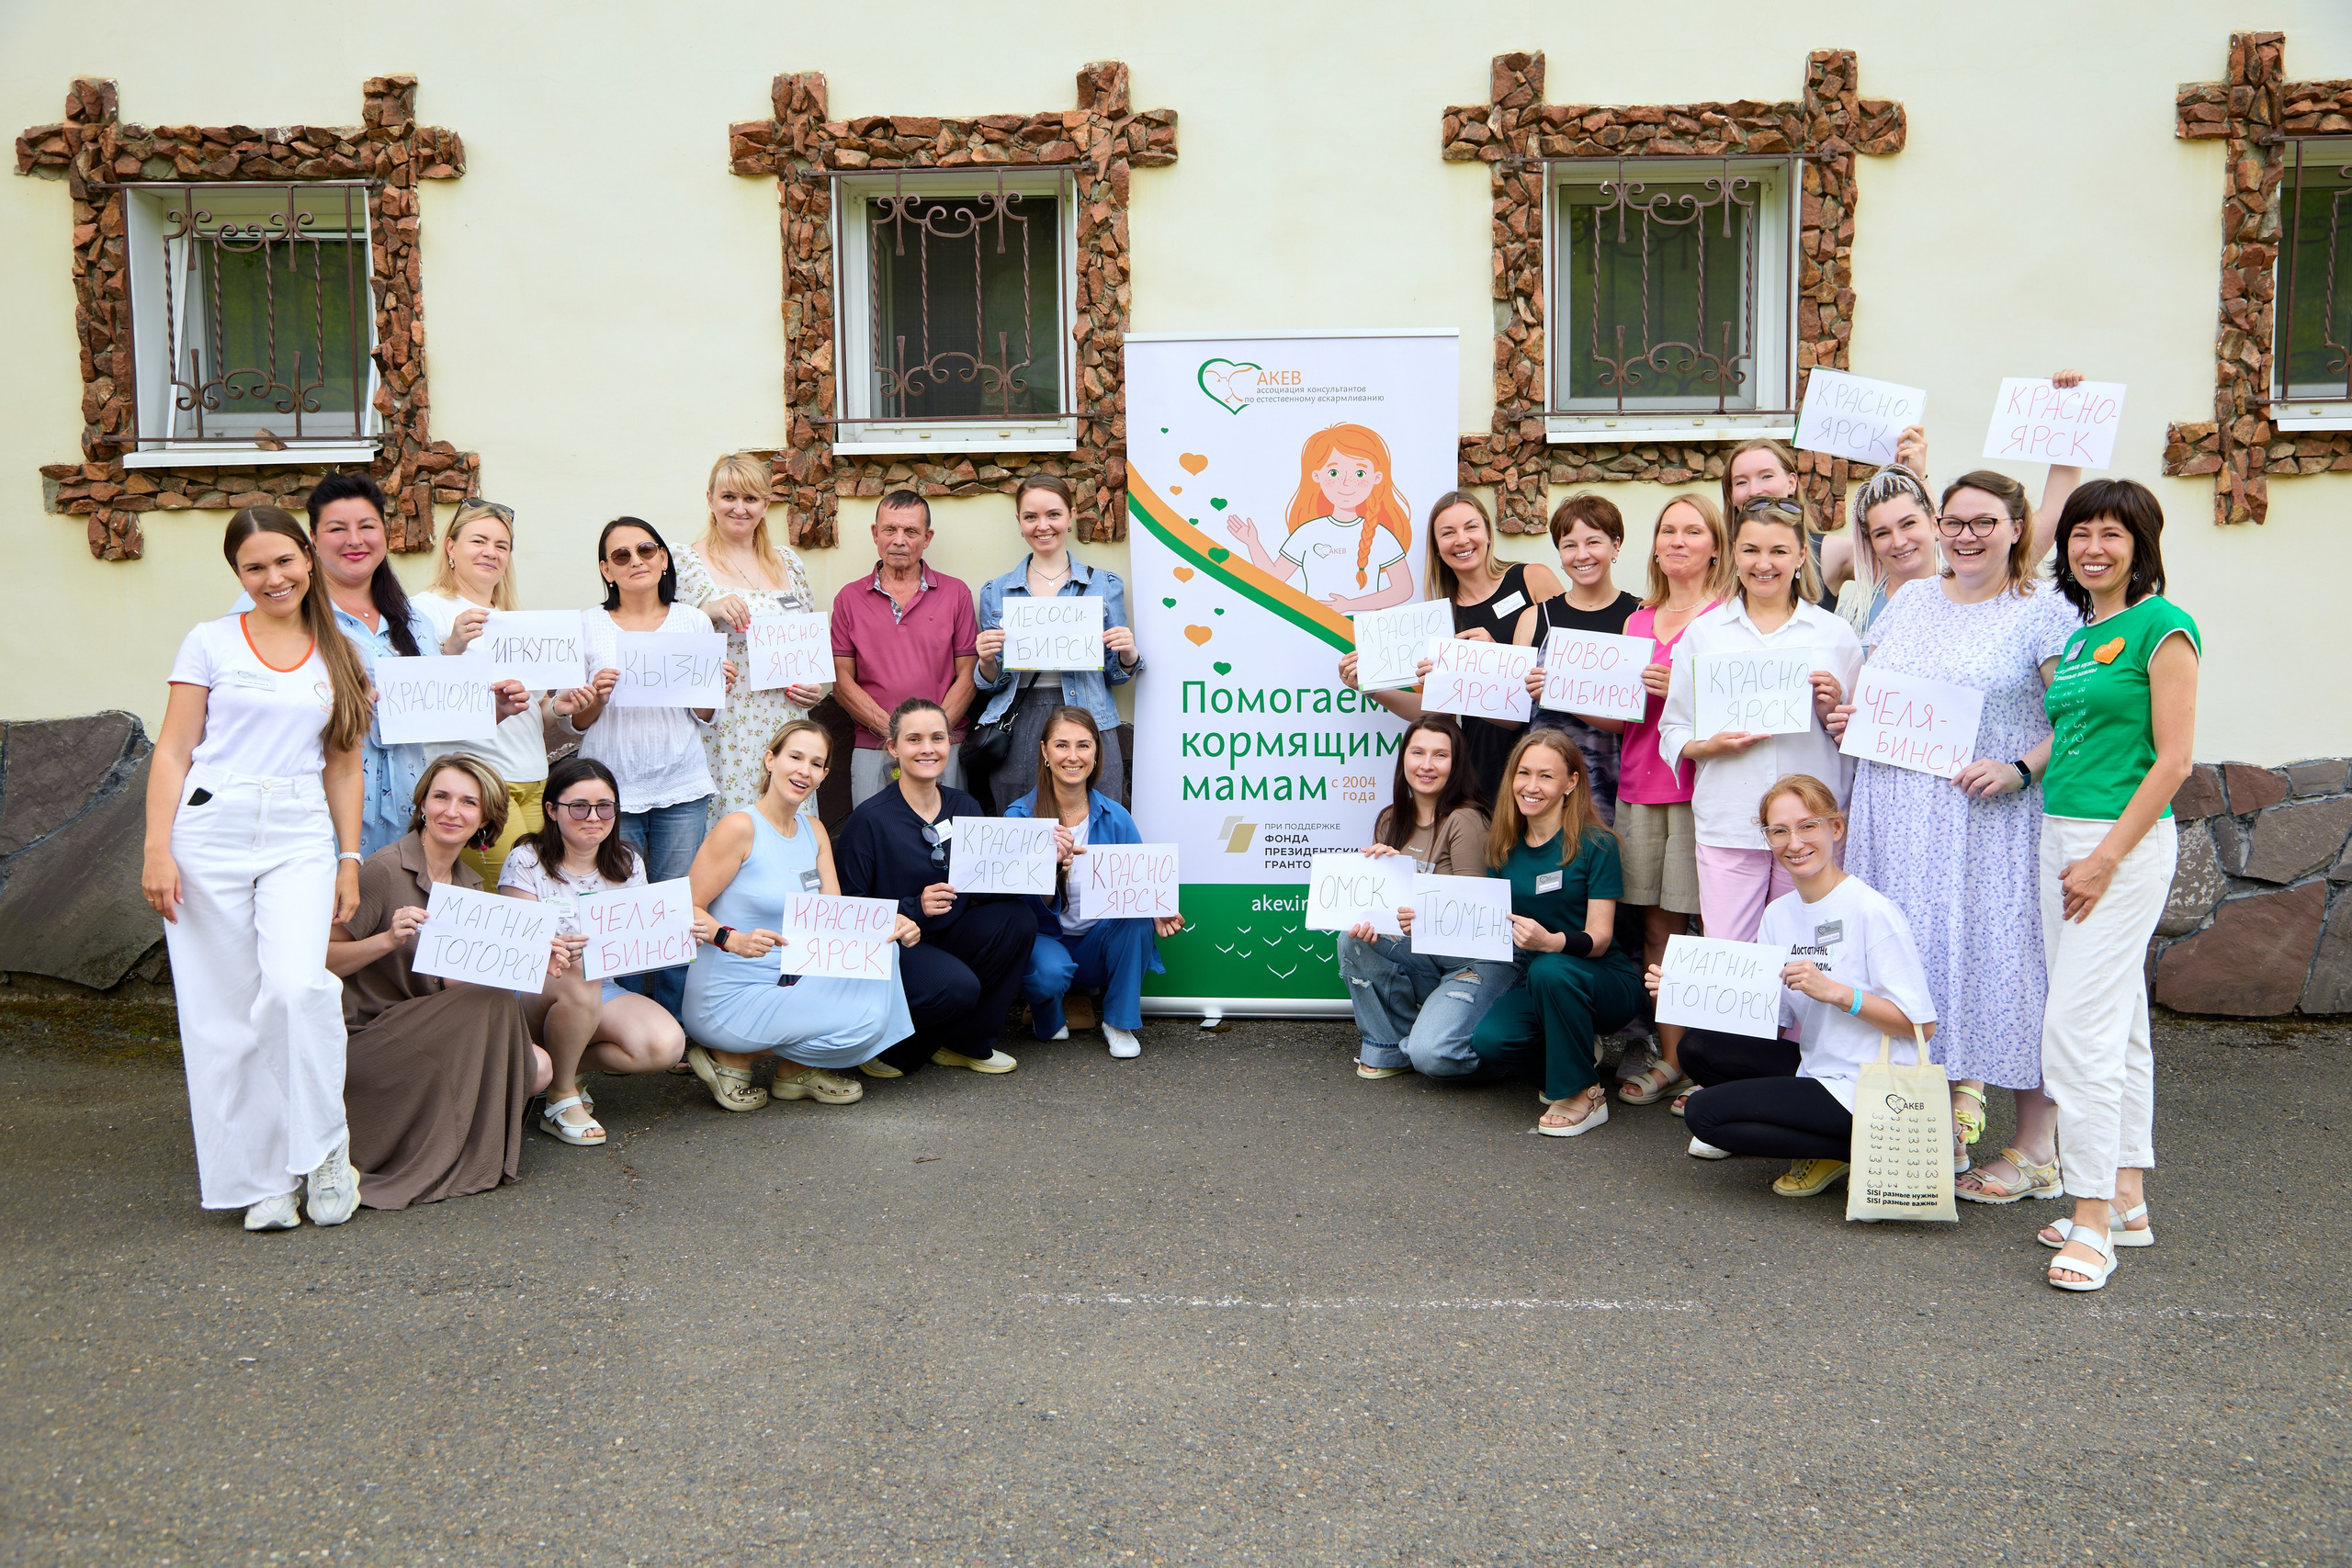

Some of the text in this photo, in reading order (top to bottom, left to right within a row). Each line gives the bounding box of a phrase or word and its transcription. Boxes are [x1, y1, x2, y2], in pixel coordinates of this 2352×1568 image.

[1256, 370, 1302, 386] АКЕВ
[1256, 386, 1366, 395] ассоциация консультантов
[1256, 396, 1315, 404] естественному
[1317, 395, 1385, 404] вскармливанию
[1815, 379, 1913, 417] КРАСНО-
[2007, 385, 2117, 424] КРАСНО-
[1814, 416, 1891, 457] ЯРСК
[2000, 424, 2094, 463] ЯРСК
[1009, 605, 1087, 628] ЛЕСОСИ-
[1361, 609, 1445, 649] КРАСНО-
[492, 637, 578, 663] ИРКУТСК
[752, 622, 824, 649] КРАСНО-
[1016, 636, 1097, 661] БИРСК
[1551, 635, 1629, 671] НОВО-
[624, 650, 724, 689] КЫЗЫЛ
[766, 647, 826, 682] ЯРСК
[1370, 640, 1424, 680] ЯРС
[384, 680, 493, 716] КРАСНОЯРСК
[1182, 681, 1388, 714] Помогаем
[1436, 678, 1521, 714] ЯРСК
[1547, 675, 1644, 709] СИБИРСК
[1865, 684, 1948, 732] ЧЕЛЯ-
[1720, 696, 1802, 732] ЯРСК
[1182, 731, 1403, 770] кормящим
[1876, 730, 1968, 774] БИНСК
[1182, 775, 1328, 801] мамам
[1342, 776, 1376, 788] 2004
[1342, 791, 1376, 804] года
[962, 822, 1054, 856] КРАСНО-
[1264, 834, 1309, 844] ФОНДА
[1264, 847, 1361, 857] ПРЕЗИДЕНТСКИ
[963, 860, 1043, 891] ЯРСК
[1091, 852, 1176, 890] КРАСНО-
[1264, 860, 1311, 869] ГРАНТО
[1095, 888, 1171, 918] ЯРСК
[1318, 874, 1389, 909] ОМСК
[435, 896, 544, 941] МАГНИ-
[590, 899, 676, 935] ЧЕЛЯ-
[794, 897, 890, 932] КРАСНО-
[1417, 889, 1511, 945] ТЮМЕНЬ
[434, 934, 545, 984] ТОГОРСК
[601, 930, 693, 971] БИНСК
[795, 938, 884, 975] ЯРСК
[1670, 947, 1763, 979] МАГНИ-
[1667, 982, 1778, 1024] ТОГОРСК
[1903, 1101, 1925, 1111] АКЕВ
[1866, 1189, 1881, 1197] SISI
